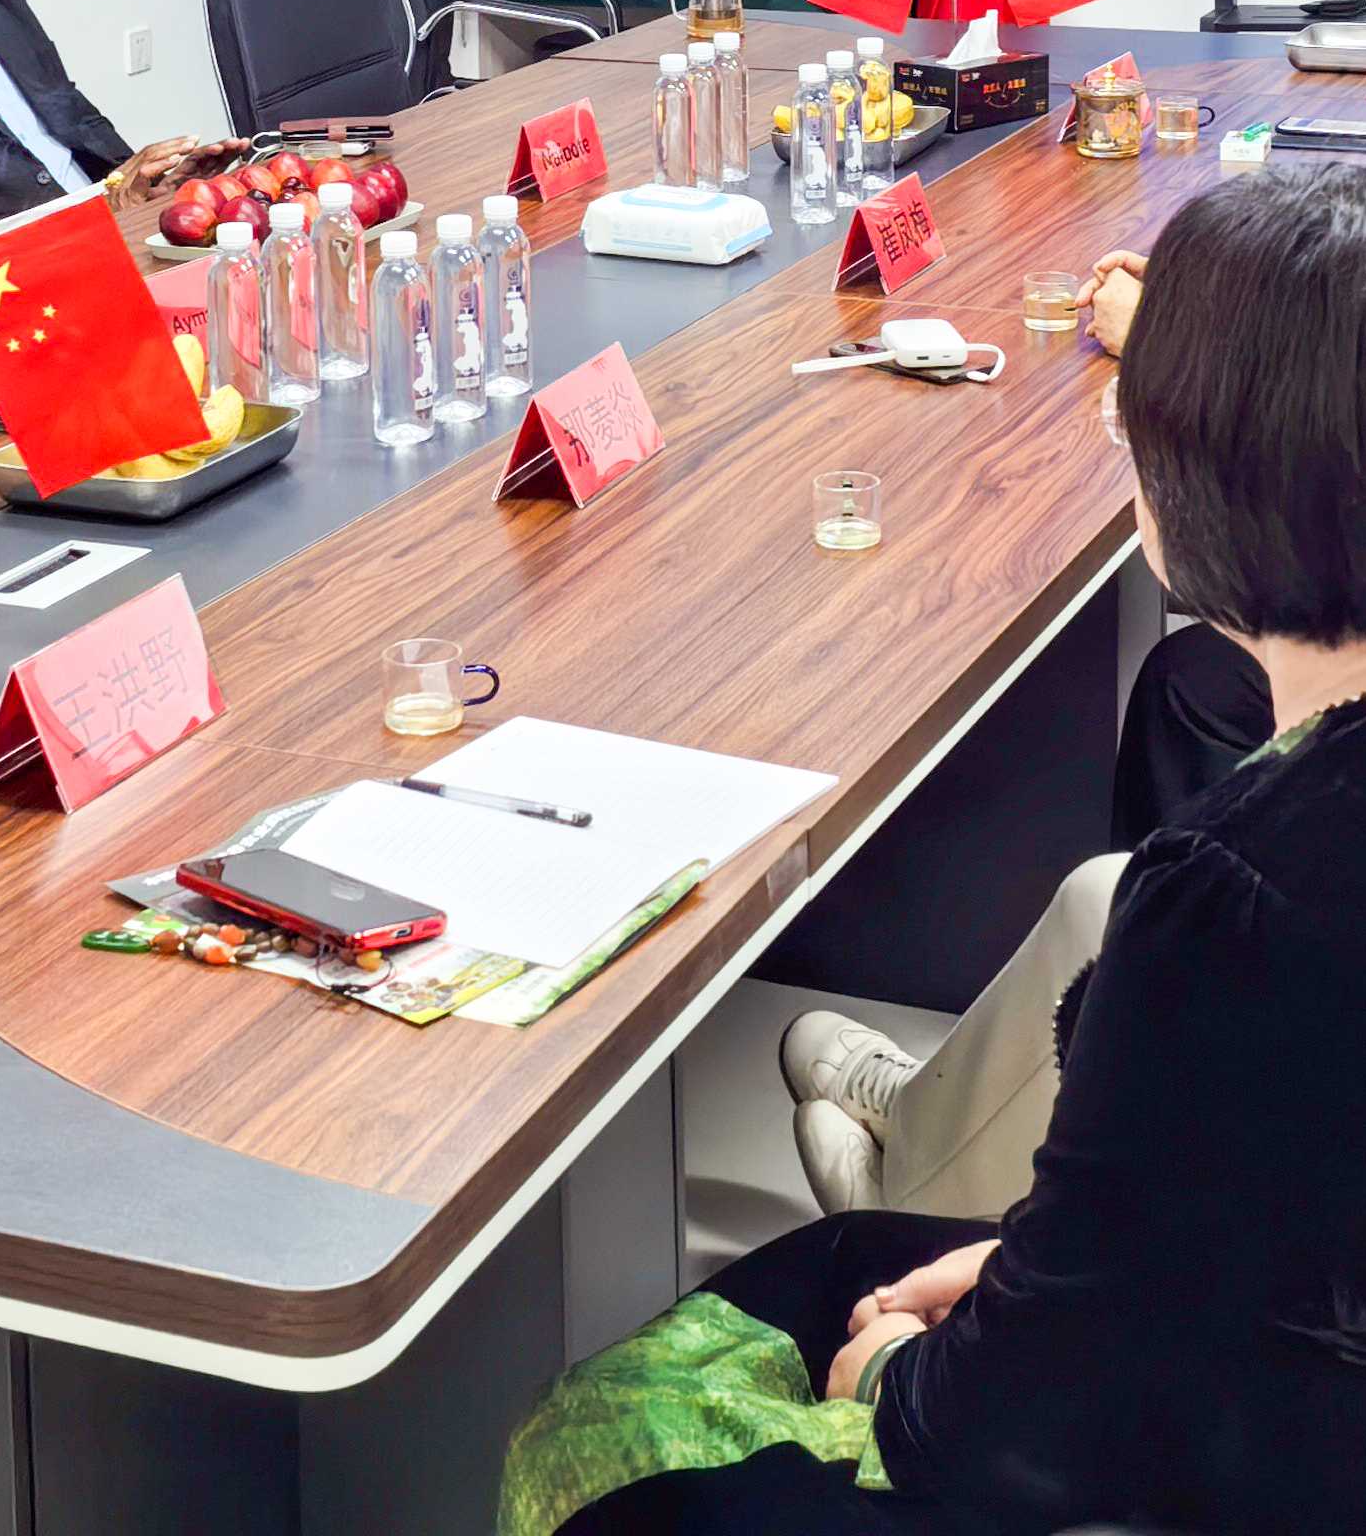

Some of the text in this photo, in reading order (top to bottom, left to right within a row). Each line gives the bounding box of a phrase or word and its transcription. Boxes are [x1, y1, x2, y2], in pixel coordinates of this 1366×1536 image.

[172, 308, 209, 335] Aym
[53, 624, 187, 761] 王洪野
